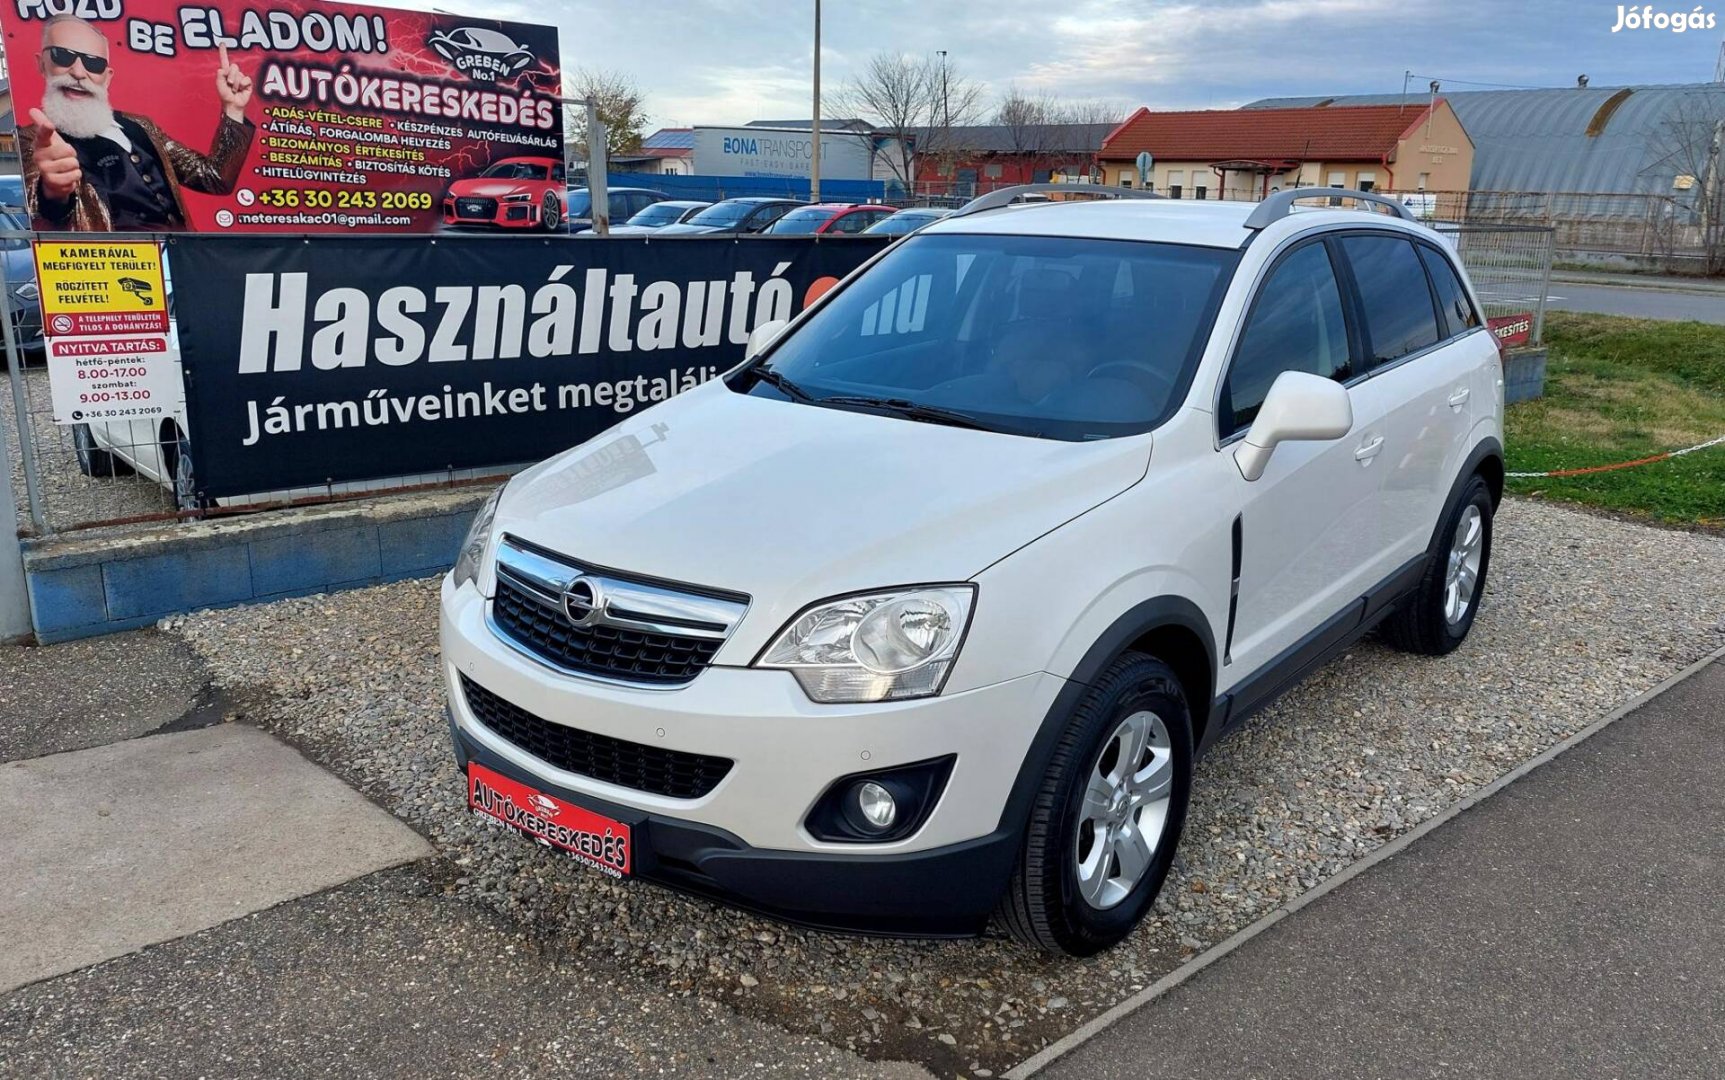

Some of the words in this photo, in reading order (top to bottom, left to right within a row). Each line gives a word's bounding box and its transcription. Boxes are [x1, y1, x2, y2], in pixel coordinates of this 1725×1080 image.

[129, 19, 175, 56] BE
[180, 8, 387, 52] ELADOM!
[456, 54, 510, 77] GREBEN
[472, 68, 495, 82] No.1
[263, 64, 554, 130] AUTÓKERESKEDÉS
[271, 107, 383, 129] ADÁS-VÉTEL-CSERE
[269, 121, 316, 137] ÁTÍRÁS,
[319, 127, 398, 145] FORGALOMBA
[401, 136, 451, 150] HELYEZÉS
[397, 121, 463, 138] KÉSZPÉNZES
[467, 129, 558, 149] AUTÓFELVÁSÁRLÁS
[269, 136, 350, 154] BIZOMÁNYOS
[355, 144, 425, 161] ÉRTÉKESÍTÉS
[269, 151, 343, 168] BESZÁMÍTÁS
[355, 159, 416, 175] BIZTOSÍTÁS
[262, 166, 367, 184] HITELÜGYINTÉZÉS
[259, 189, 299, 207] +36
[304, 190, 332, 208] 30
[337, 191, 377, 208] 243
[381, 192, 432, 209] 2069
[60, 247, 137, 258] KAMERÁVAL
[43, 261, 106, 271] MEGFIGYELT
[109, 261, 156, 271] TERÜLET!
[56, 280, 109, 291] RÖGZÍTETT
[59, 294, 109, 304] FELVÉTEL!
[86, 315, 122, 323] TELEPHELY
[124, 313, 161, 322] TERÜLETÉN
[79, 324, 102, 332] TILOS
[104, 323, 110, 331] A
[112, 321, 162, 331] DOHÁNYZÁS!
[59, 343, 108, 355] NYITVA
[110, 340, 160, 352] TARTÁS:
[78, 367, 147, 380] 8.00-17.00
[92, 380, 137, 389] szombat:
[80, 390, 151, 403] 9.00-13.00
[85, 410, 103, 418] +36
[105, 409, 118, 417] 30
[120, 408, 137, 416] 243
[139, 407, 162, 415] 2069
[243, 380, 547, 446] Járműveinket
[474, 778, 626, 869] AUTÓKERESKEDÉS
